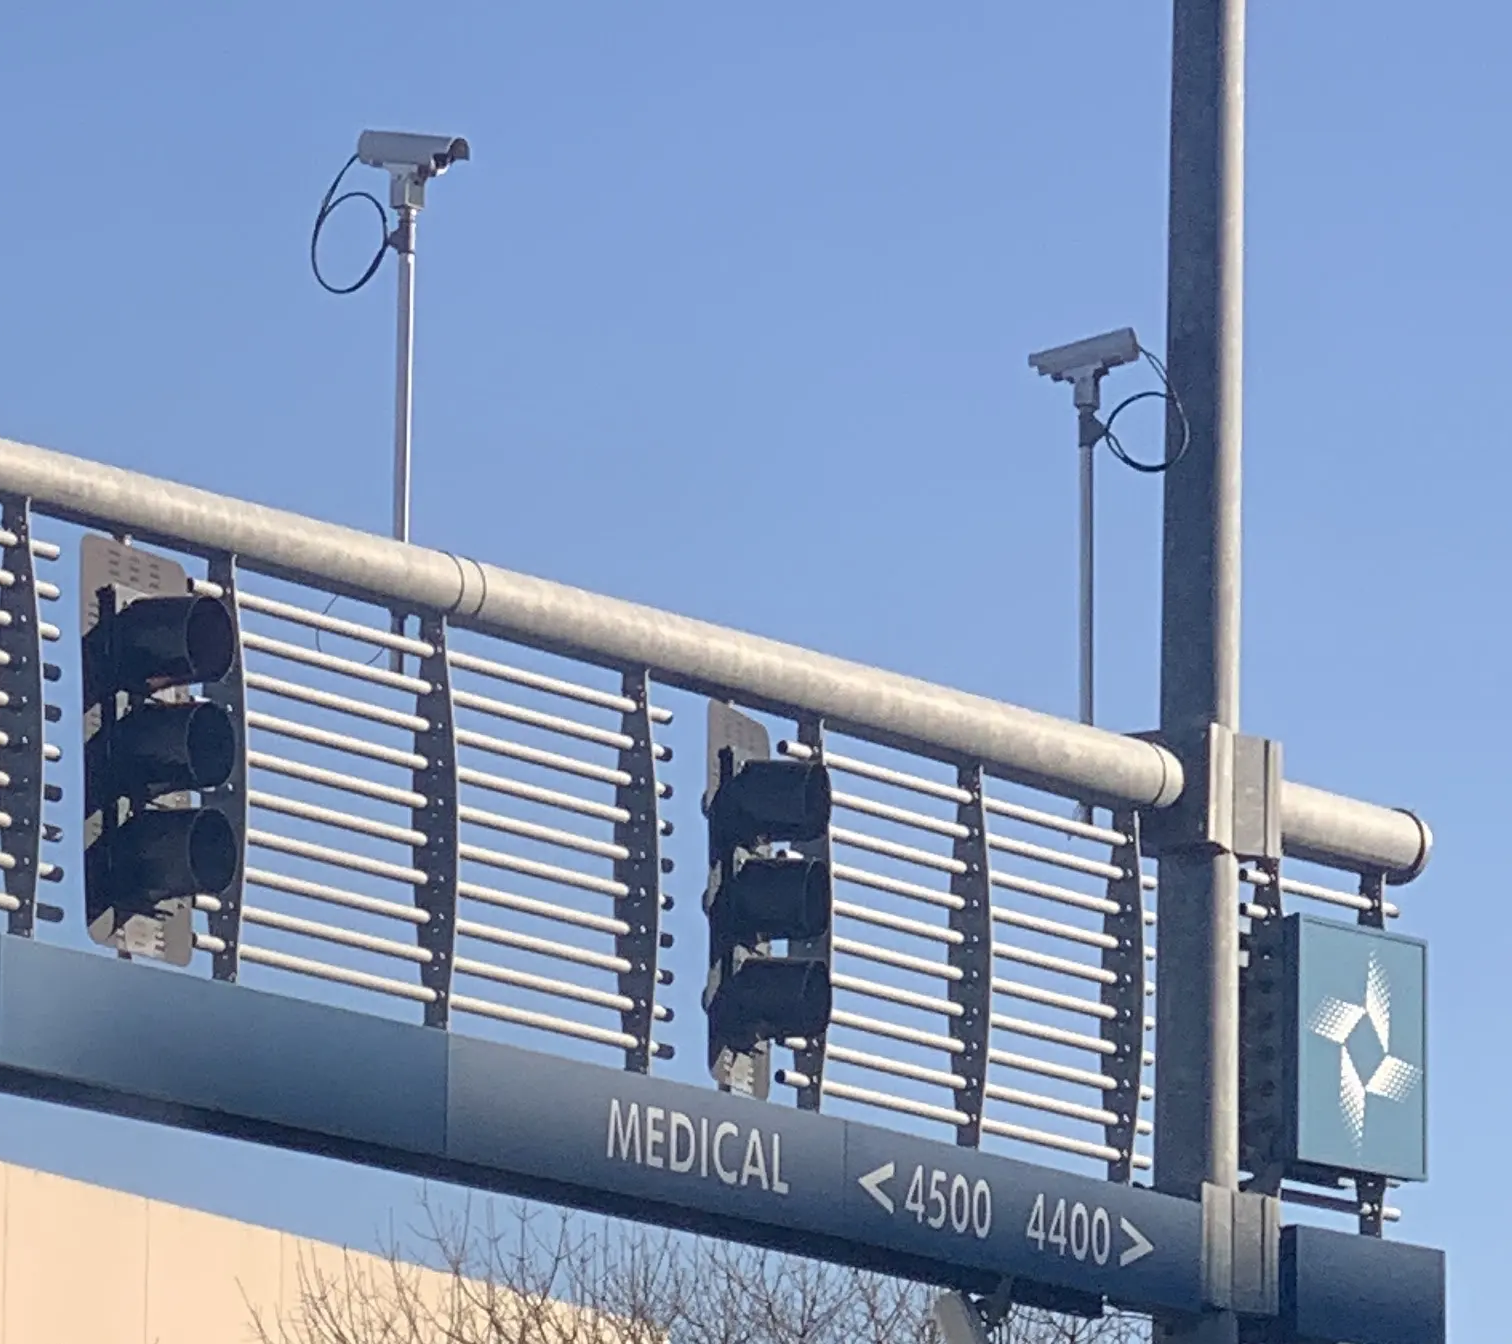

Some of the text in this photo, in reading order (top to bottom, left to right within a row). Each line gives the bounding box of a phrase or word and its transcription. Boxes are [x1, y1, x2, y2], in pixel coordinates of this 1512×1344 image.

[606, 1098, 789, 1195] MEDICAL
[904, 1163, 1112, 1267] 4500 4400
